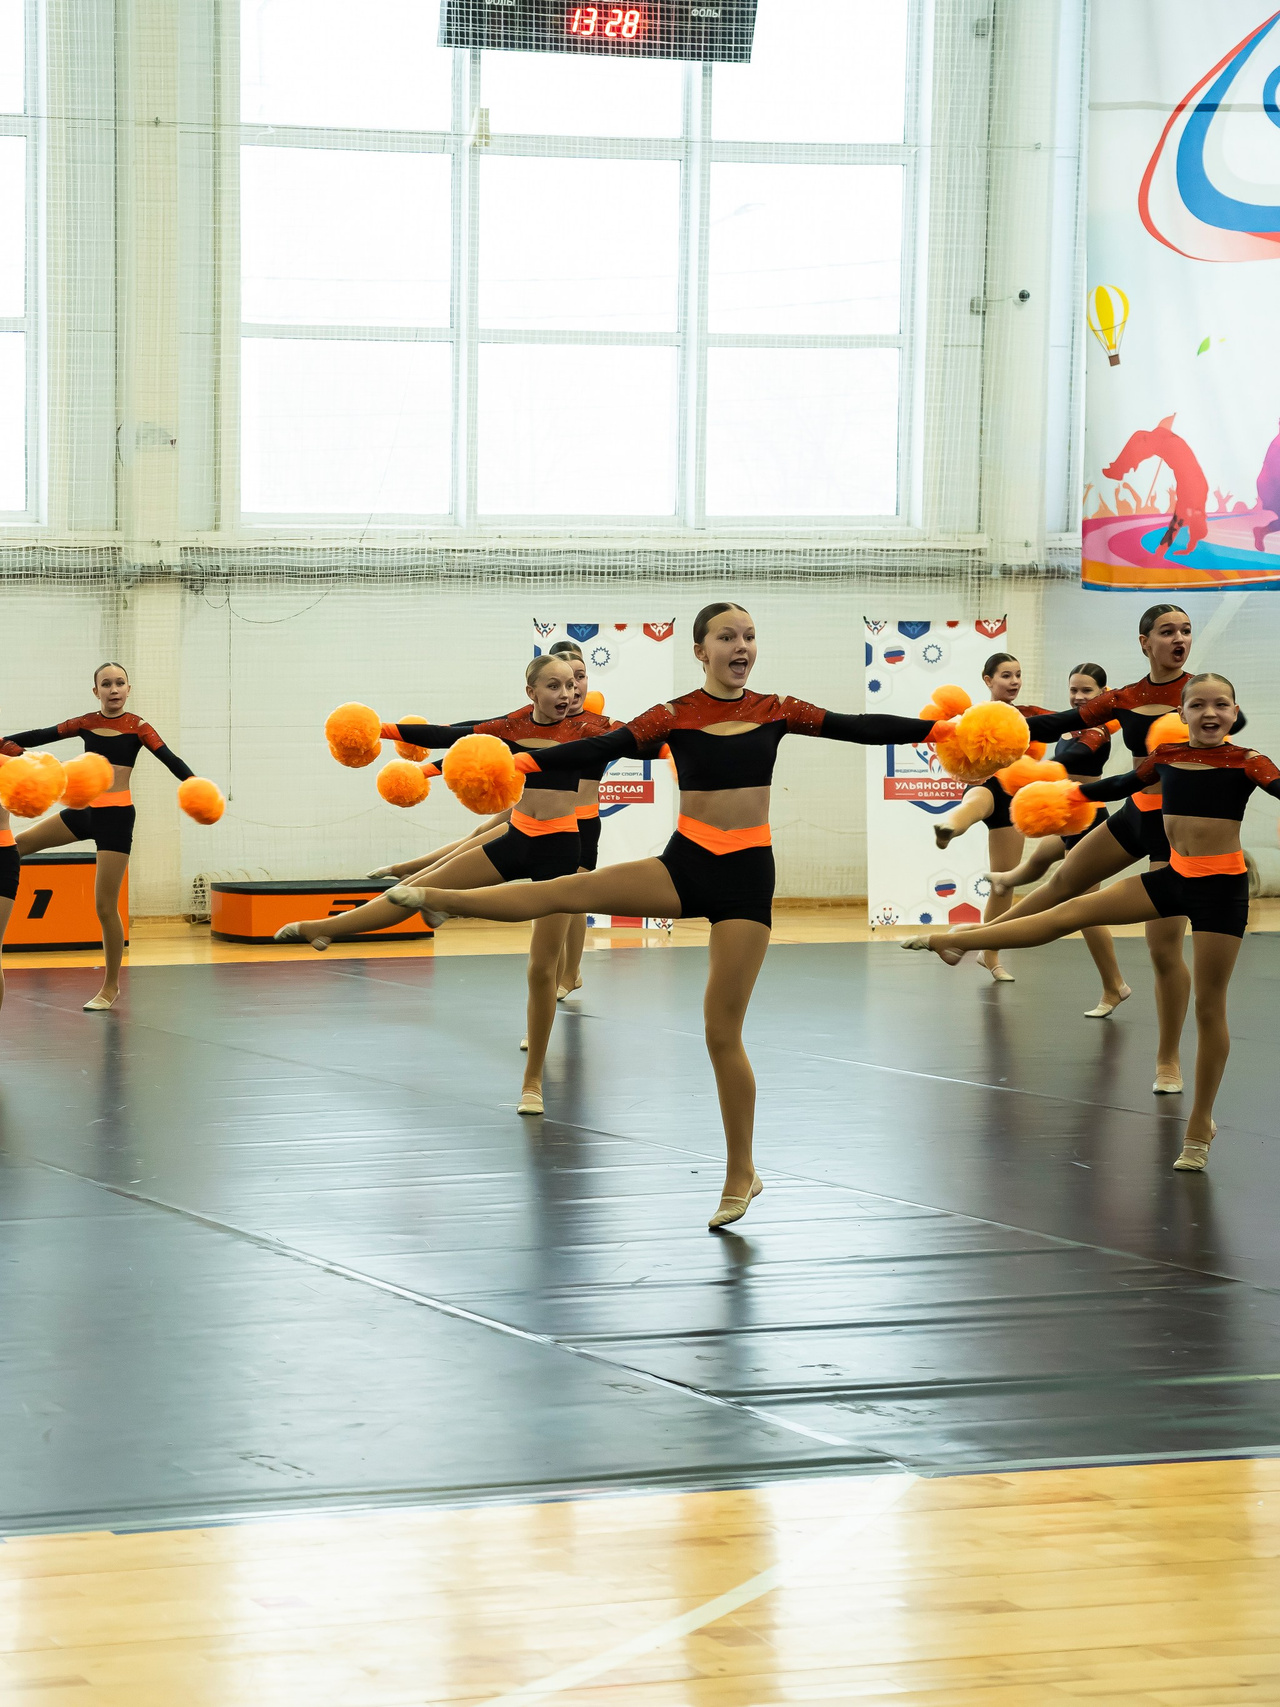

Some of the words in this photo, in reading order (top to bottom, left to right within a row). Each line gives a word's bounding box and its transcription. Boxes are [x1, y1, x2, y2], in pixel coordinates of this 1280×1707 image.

[691, 8, 721, 18] ФОЛЫ
[598, 785, 644, 793] ОВСКАЯ
[894, 781, 968, 791] УЛЬЯНОВСК
[27, 889, 54, 919] 1
